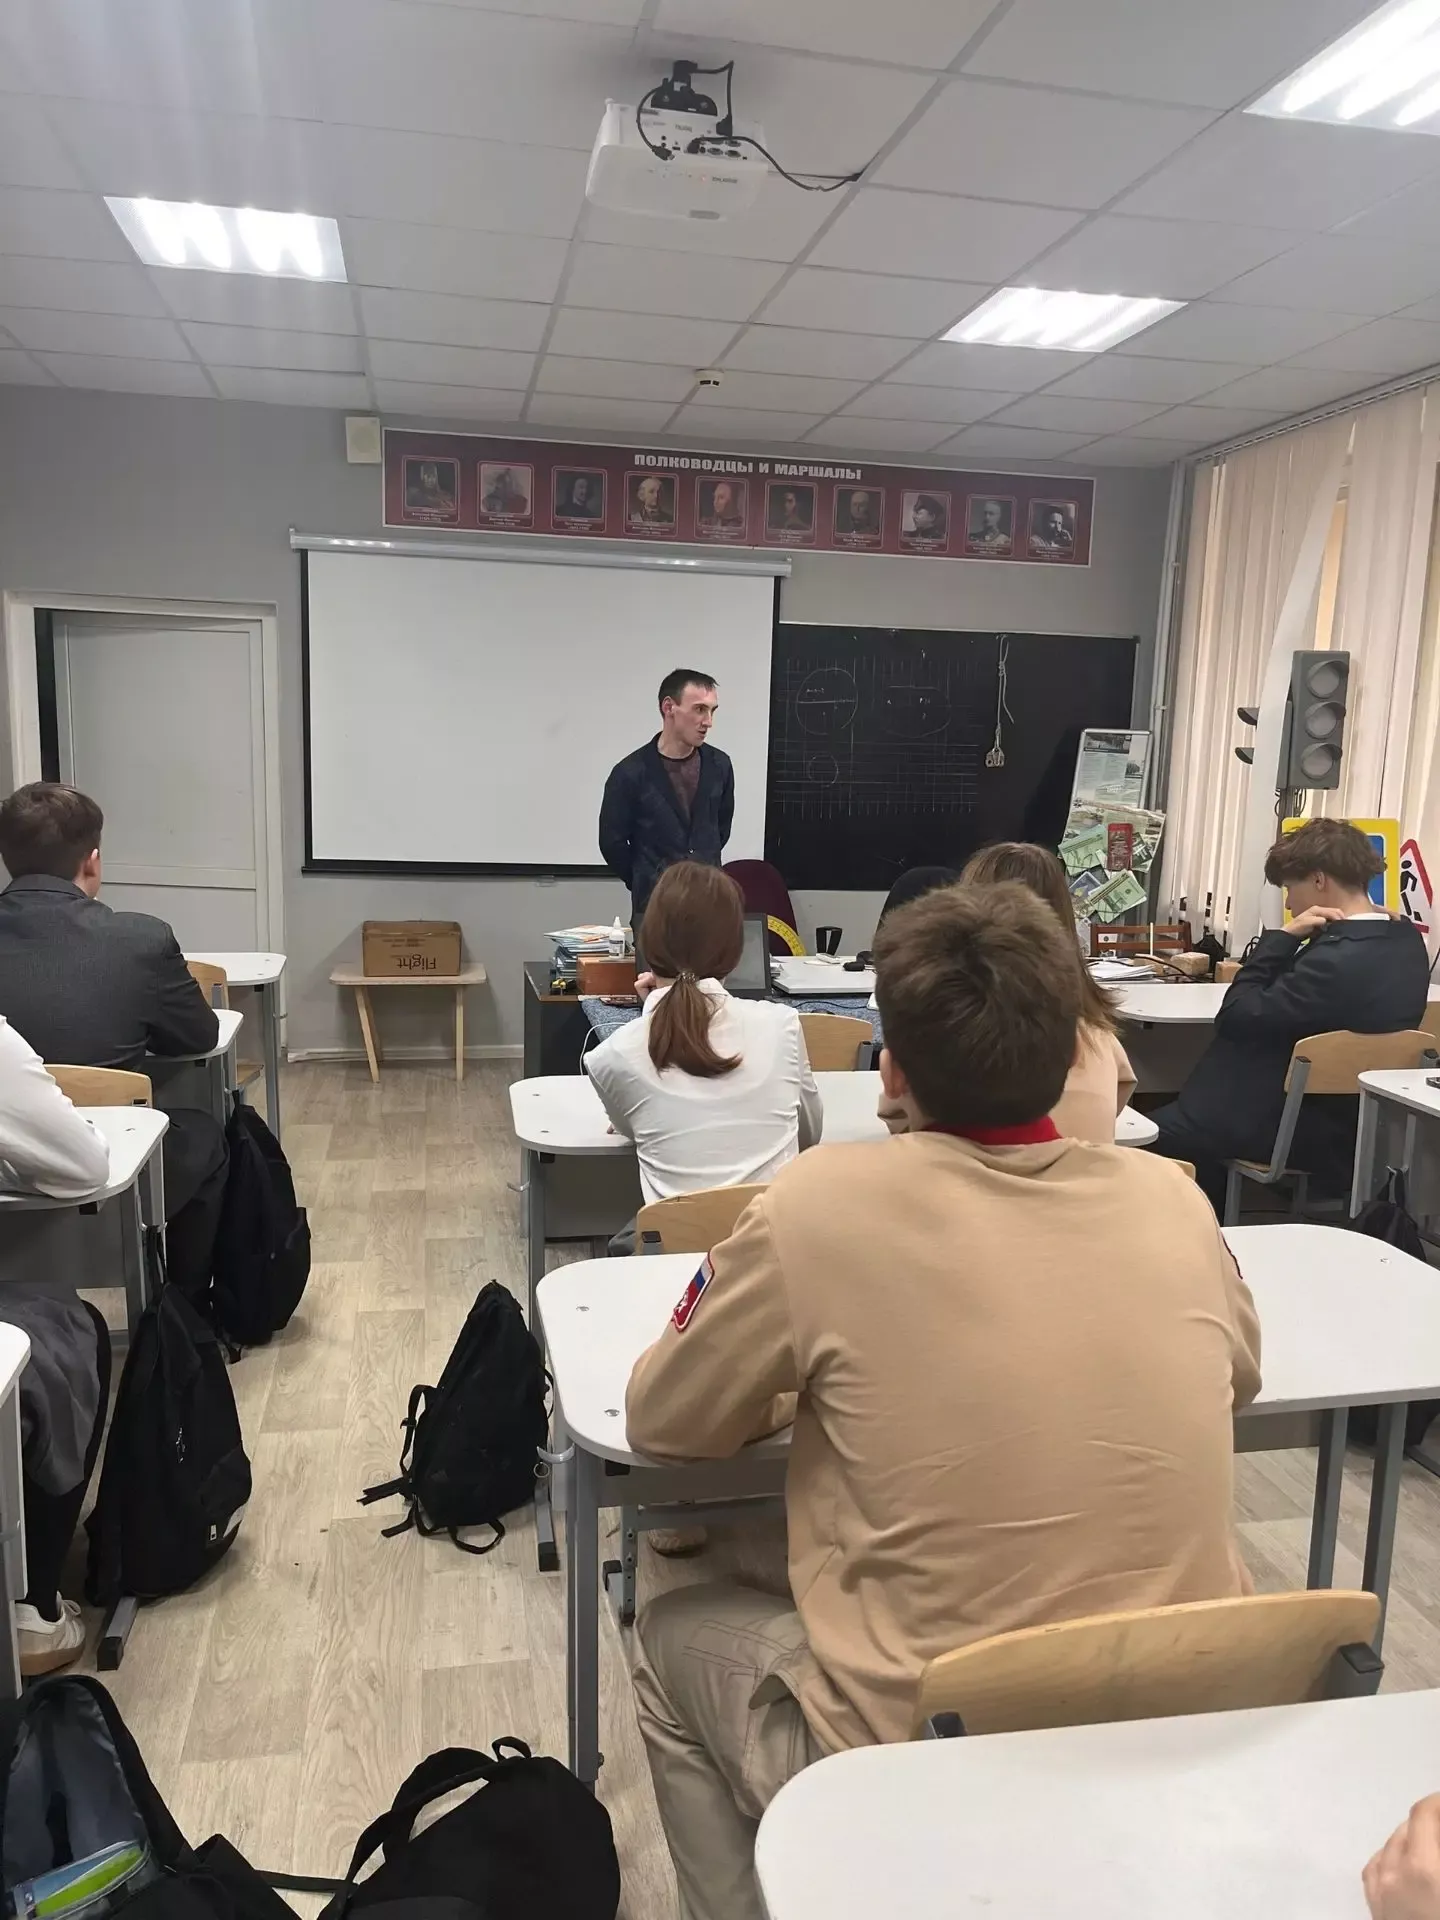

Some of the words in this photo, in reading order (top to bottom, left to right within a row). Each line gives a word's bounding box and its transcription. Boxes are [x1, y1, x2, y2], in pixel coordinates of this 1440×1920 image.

[634, 454, 753, 473] ПОЛКОВОДЦЫ
[758, 462, 769, 473] И
[774, 464, 861, 480] МАРШАЛЫ
[396, 953, 436, 970] Flight
